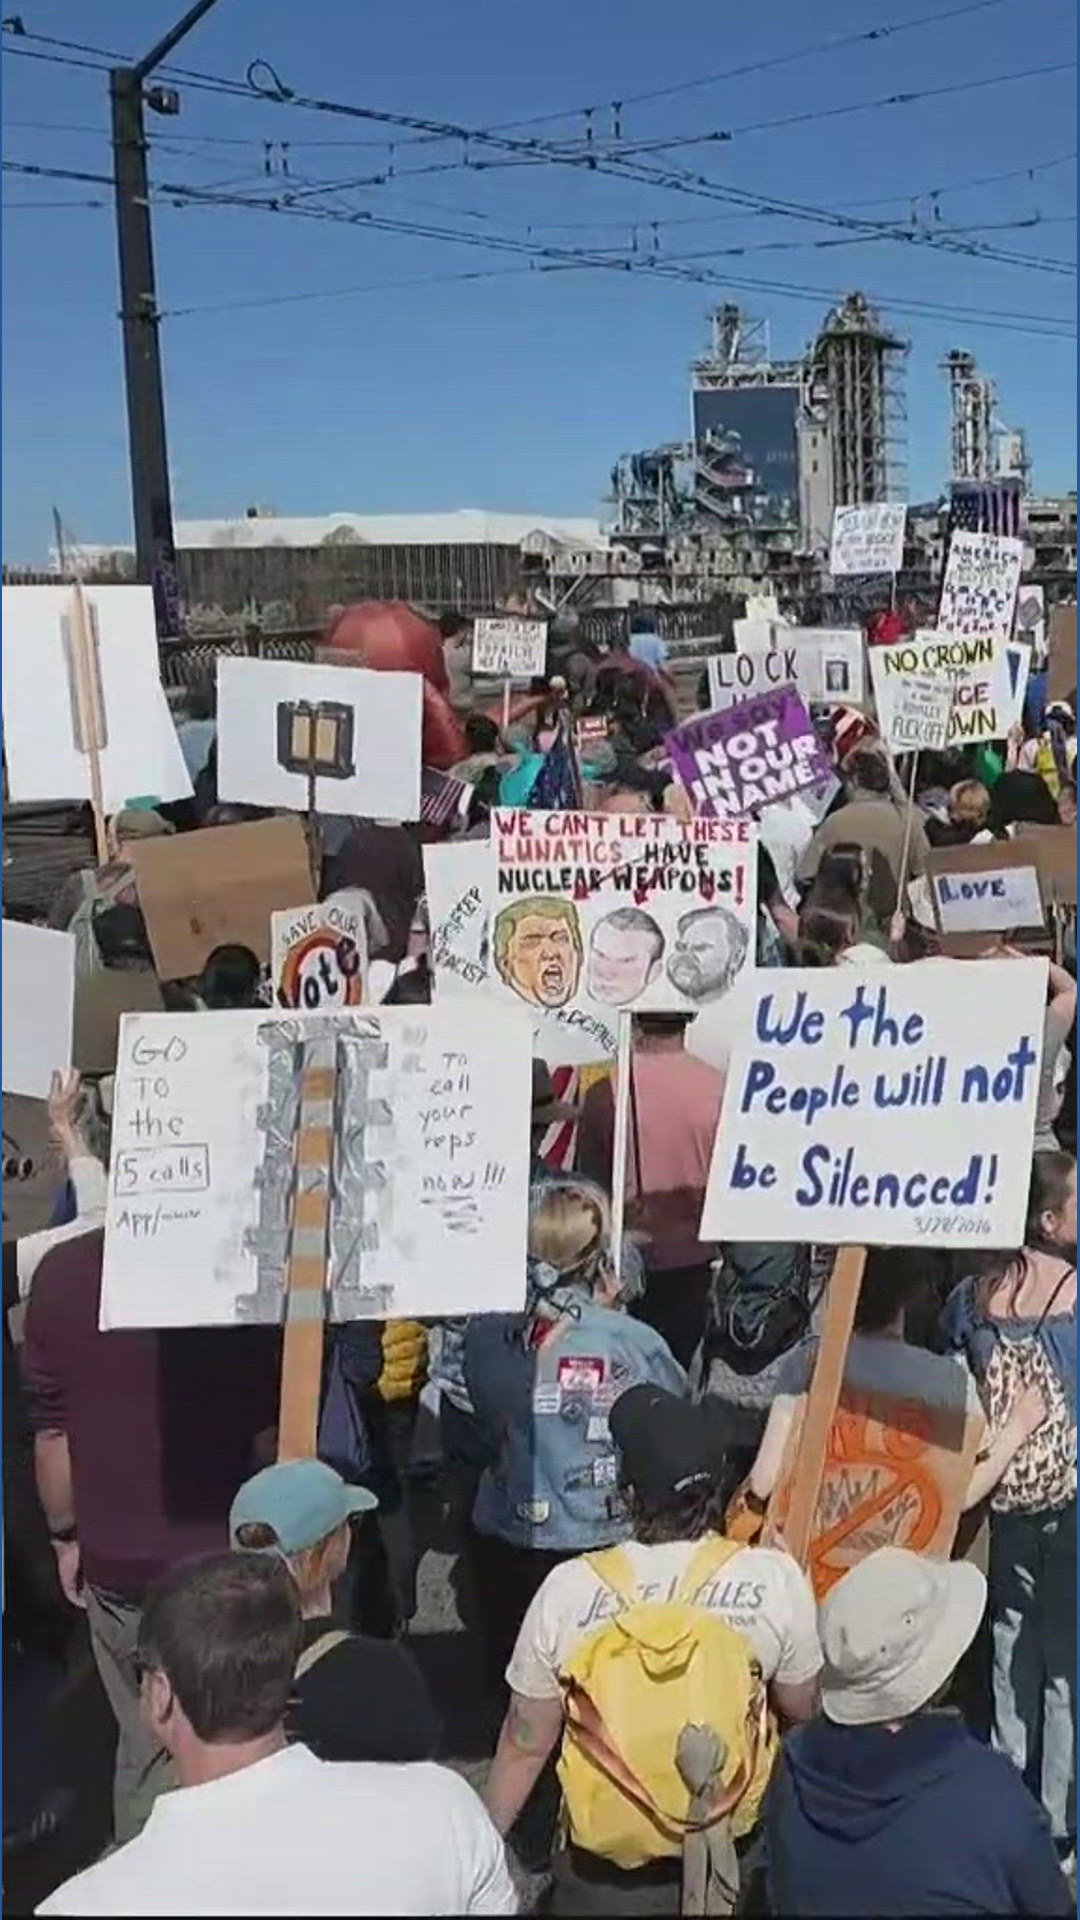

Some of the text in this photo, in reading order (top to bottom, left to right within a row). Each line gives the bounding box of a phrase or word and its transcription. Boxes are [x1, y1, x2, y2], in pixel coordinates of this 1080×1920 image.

[717, 649, 799, 688] LOCK
[884, 638, 993, 675] NO CROWN
[694, 720, 779, 775] NOT
[691, 734, 819, 801] IN OUR
[712, 761, 816, 818] NAME
[495, 812, 533, 837] WE
[619, 816, 666, 838] LET
[677, 819, 751, 843] THESE
[498, 839, 710, 867] LUNATICS HAVE
[498, 867, 602, 894] NUCLEAR
[281, 907, 360, 946] SAVE OUR
[756, 985, 924, 1048] We the
[131, 1035, 186, 1065] GO
[431, 1074, 470, 1095] call
[740, 1036, 1037, 1126] People will not
[129, 1107, 184, 1138] the
[418, 1104, 473, 1132] your
[424, 1132, 477, 1160] reps
[121, 1156, 204, 1185] 5 calls
[730, 1143, 998, 1209] be Silenced!
